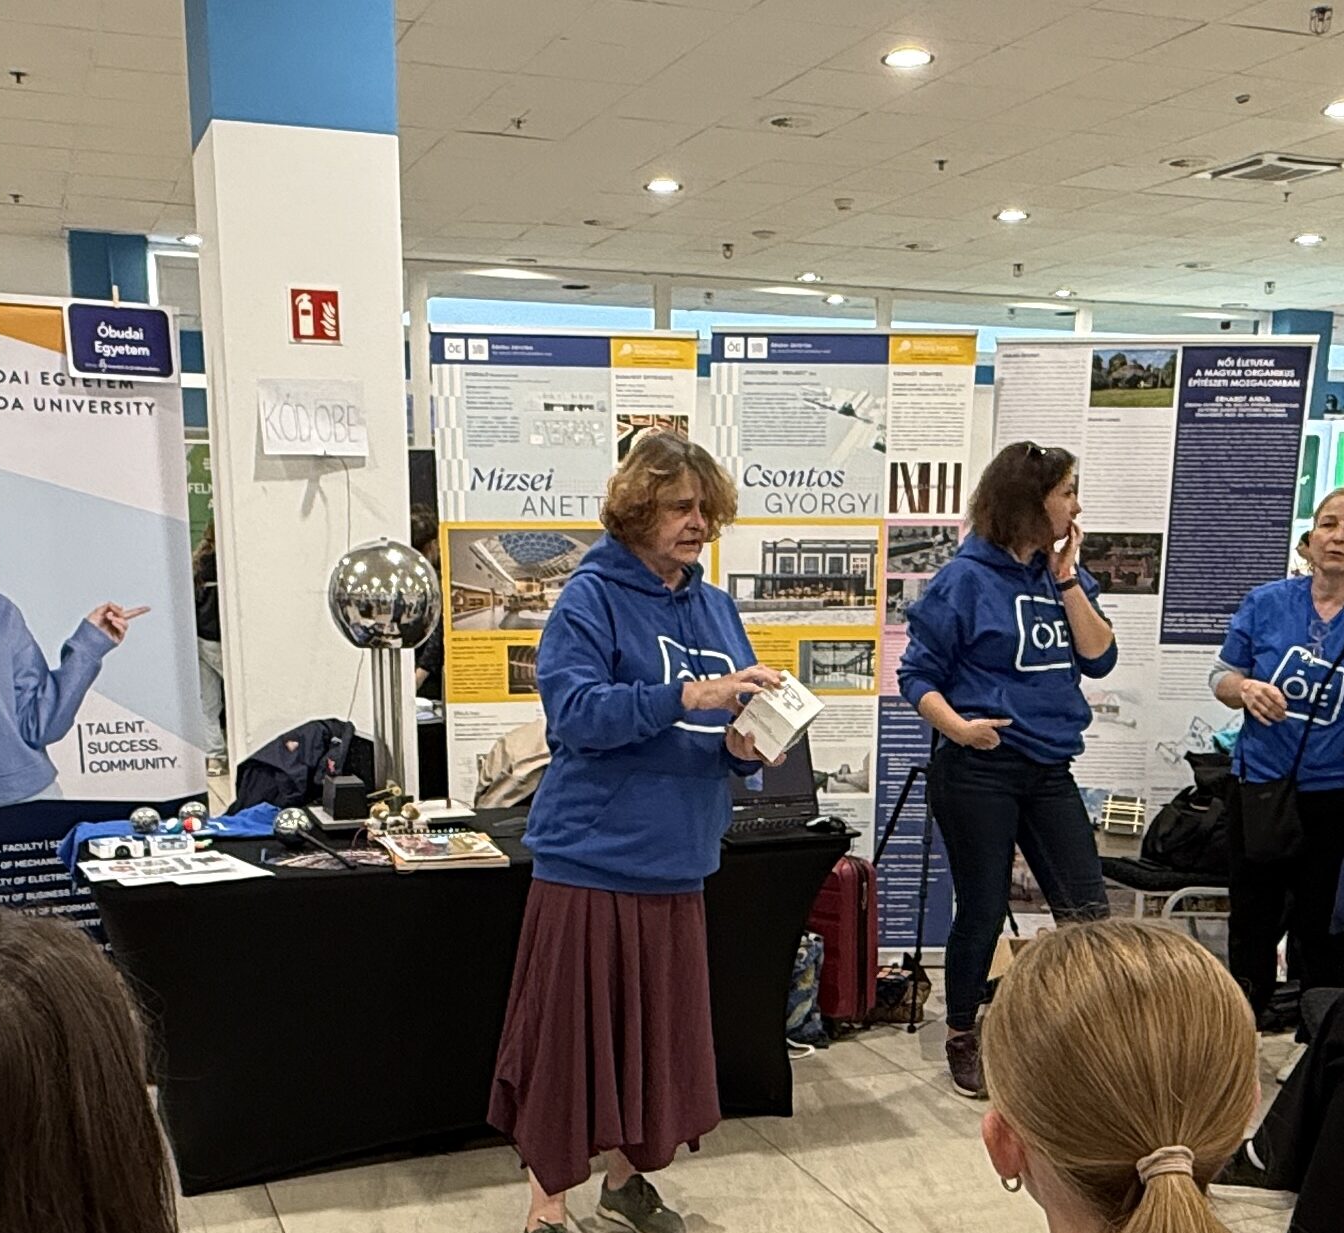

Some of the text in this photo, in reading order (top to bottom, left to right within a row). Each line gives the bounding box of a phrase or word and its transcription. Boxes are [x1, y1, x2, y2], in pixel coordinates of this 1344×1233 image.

[97, 321, 144, 340] Óbudai
[94, 340, 150, 357] Egyetem
[1217, 356, 1235, 367] NŐI
[1195, 369, 1202, 377] A
[33, 398, 156, 416] UNIVERSITY
[470, 467, 555, 492] Mizsei
[743, 464, 846, 488] Csontos
[764, 488, 879, 514] GYÖRGYI
[3, 841, 43, 853] FACULTY
[1, 860, 13, 870] OF
[14, 875, 27, 886] OF
[11, 893, 25, 903] OF
